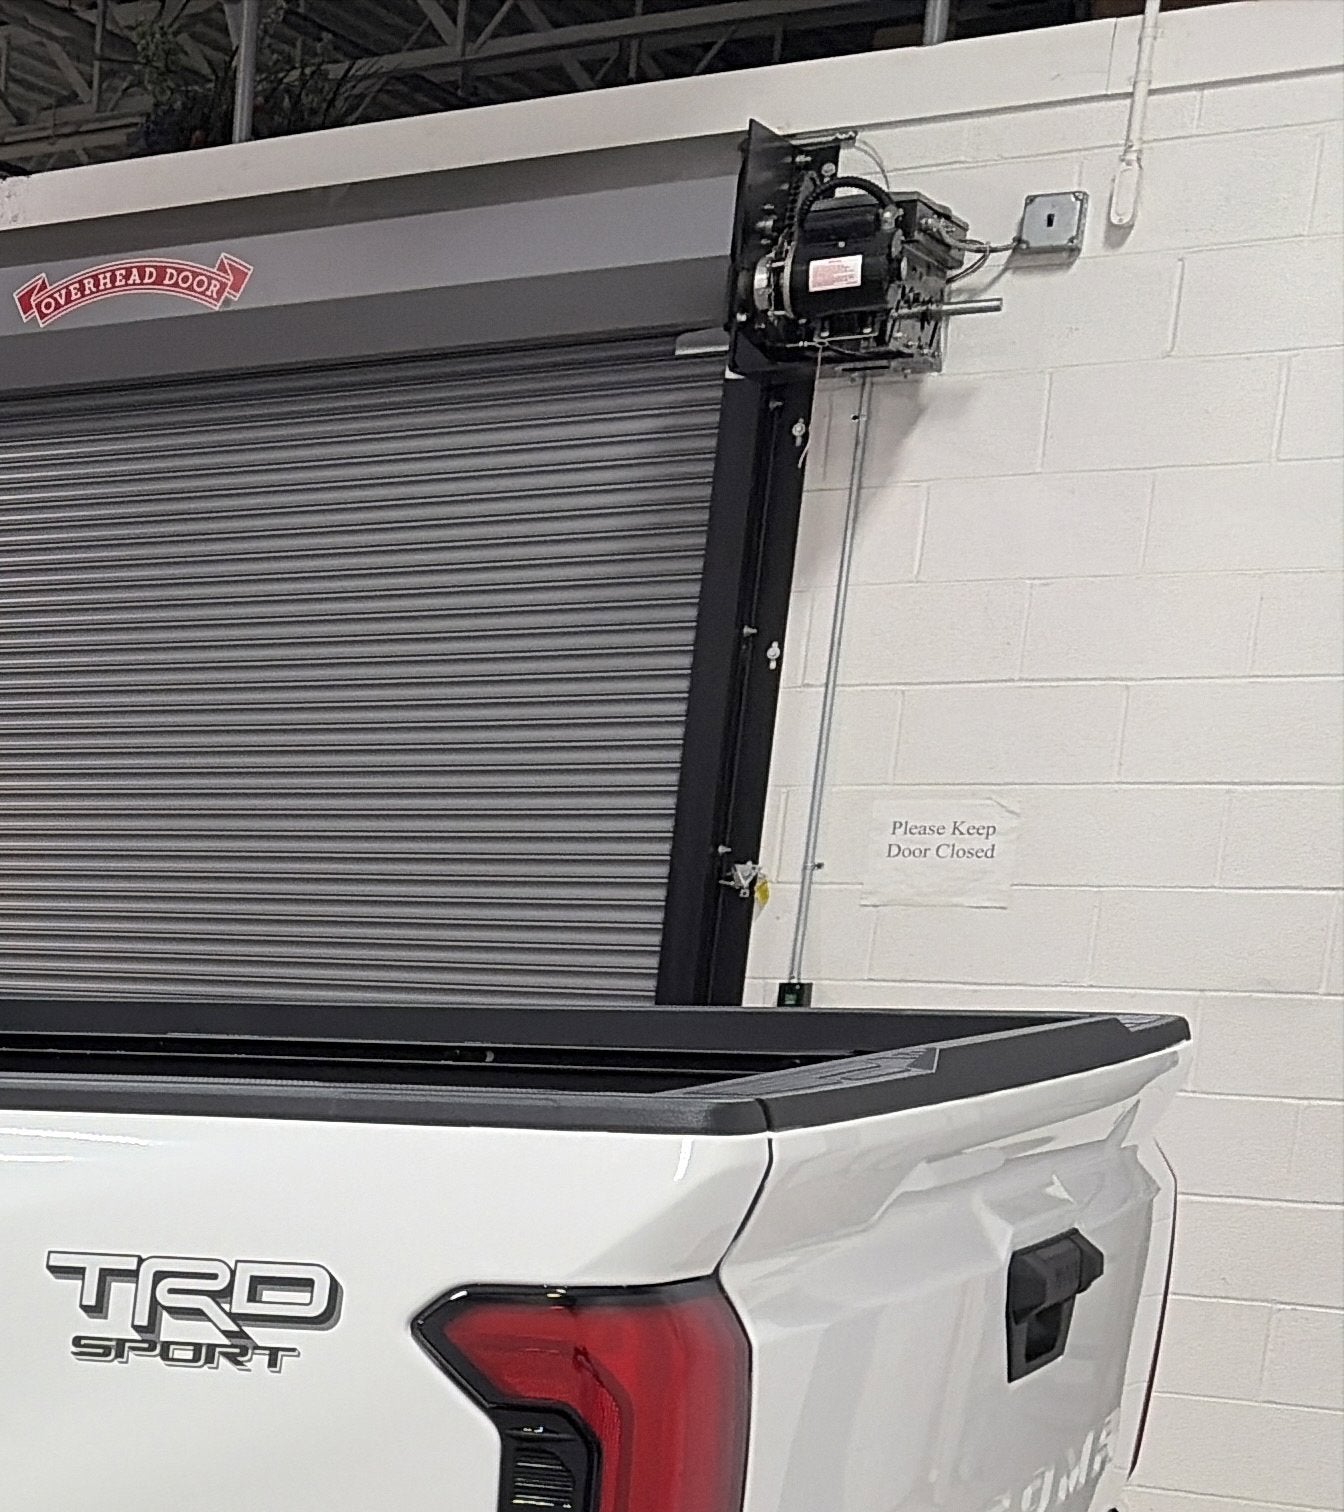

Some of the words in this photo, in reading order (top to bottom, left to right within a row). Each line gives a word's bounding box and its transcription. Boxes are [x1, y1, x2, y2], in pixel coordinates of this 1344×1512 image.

[40, 266, 157, 314] OVERHEAD
[163, 268, 221, 299] DOOR
[890, 820, 946, 836] Please
[950, 820, 997, 840] Keep
[886, 843, 931, 858] Door
[935, 843, 996, 859] Closed
[46, 1250, 344, 1346] TRD
[70, 1335, 301, 1373] SPORT
